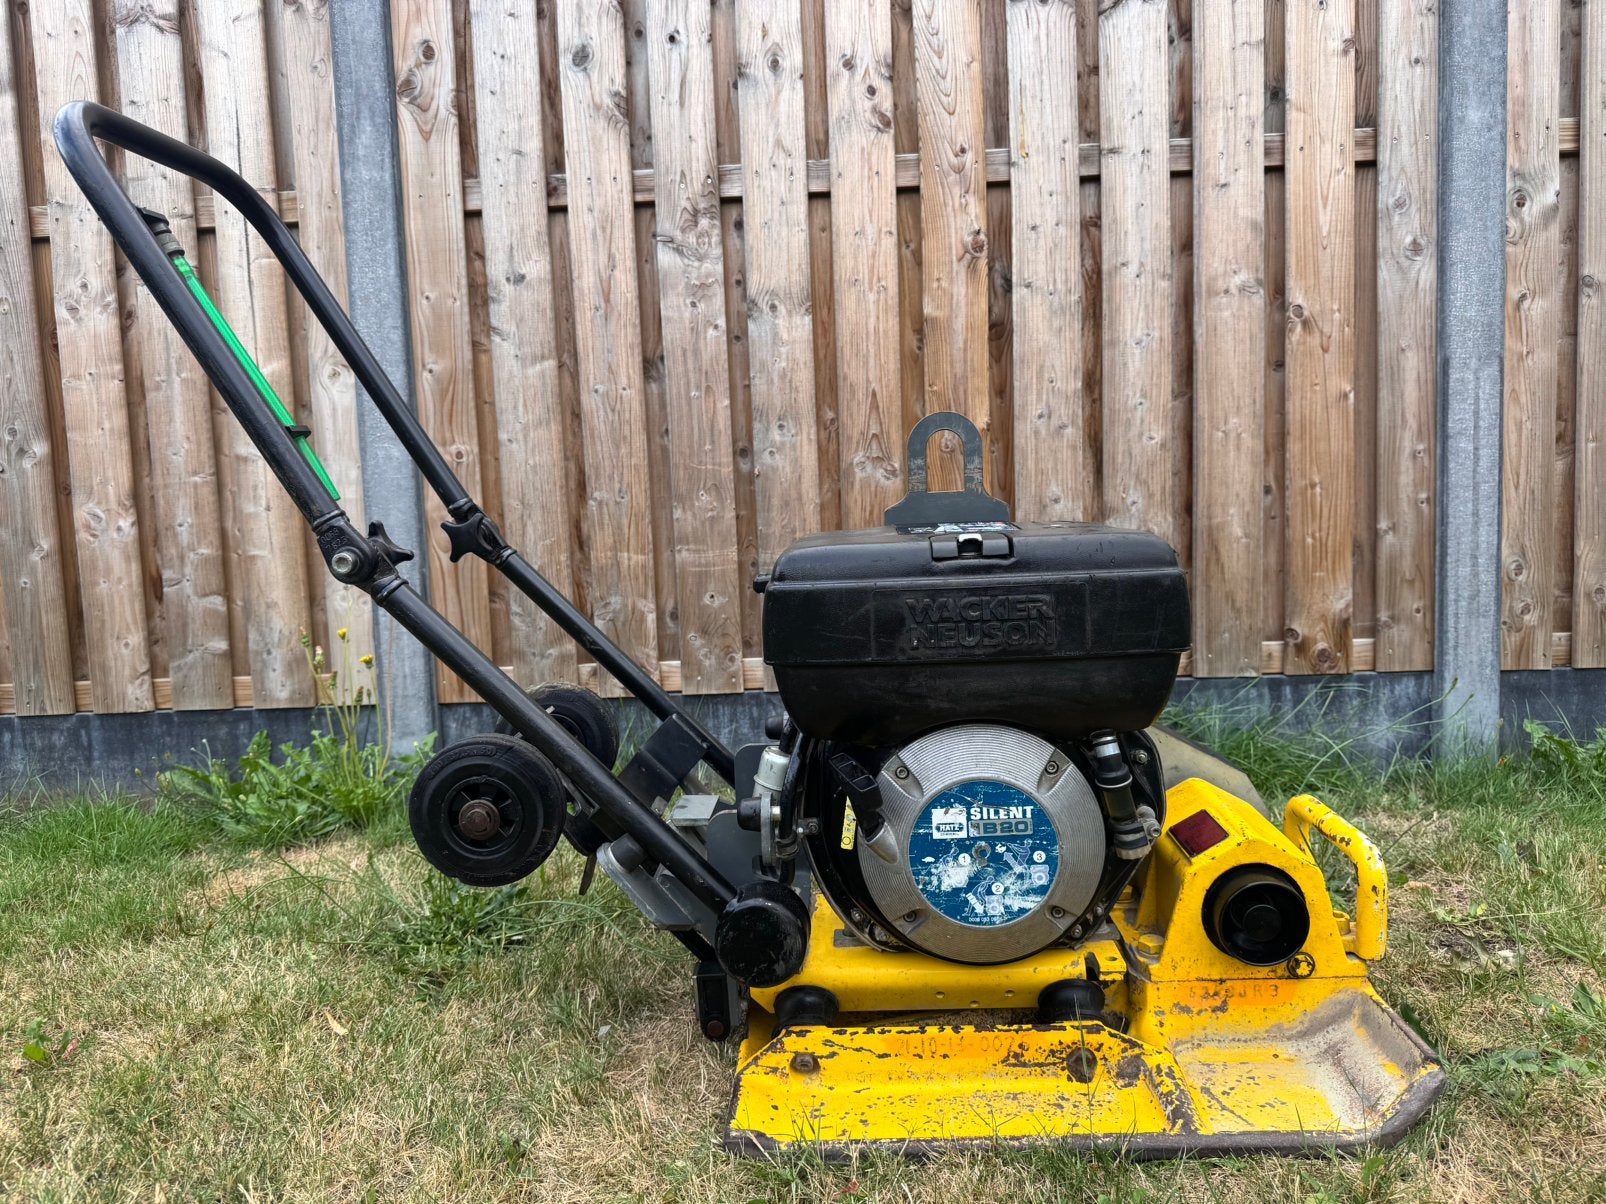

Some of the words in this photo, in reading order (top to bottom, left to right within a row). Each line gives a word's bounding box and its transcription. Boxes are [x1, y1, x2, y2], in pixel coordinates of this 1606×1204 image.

[905, 594, 1055, 623] WACKER
[910, 619, 1056, 648] NEUSON
[970, 806, 1034, 820] SILENT
[939, 824, 960, 832] HATZ
[971, 821, 1029, 835] B20
